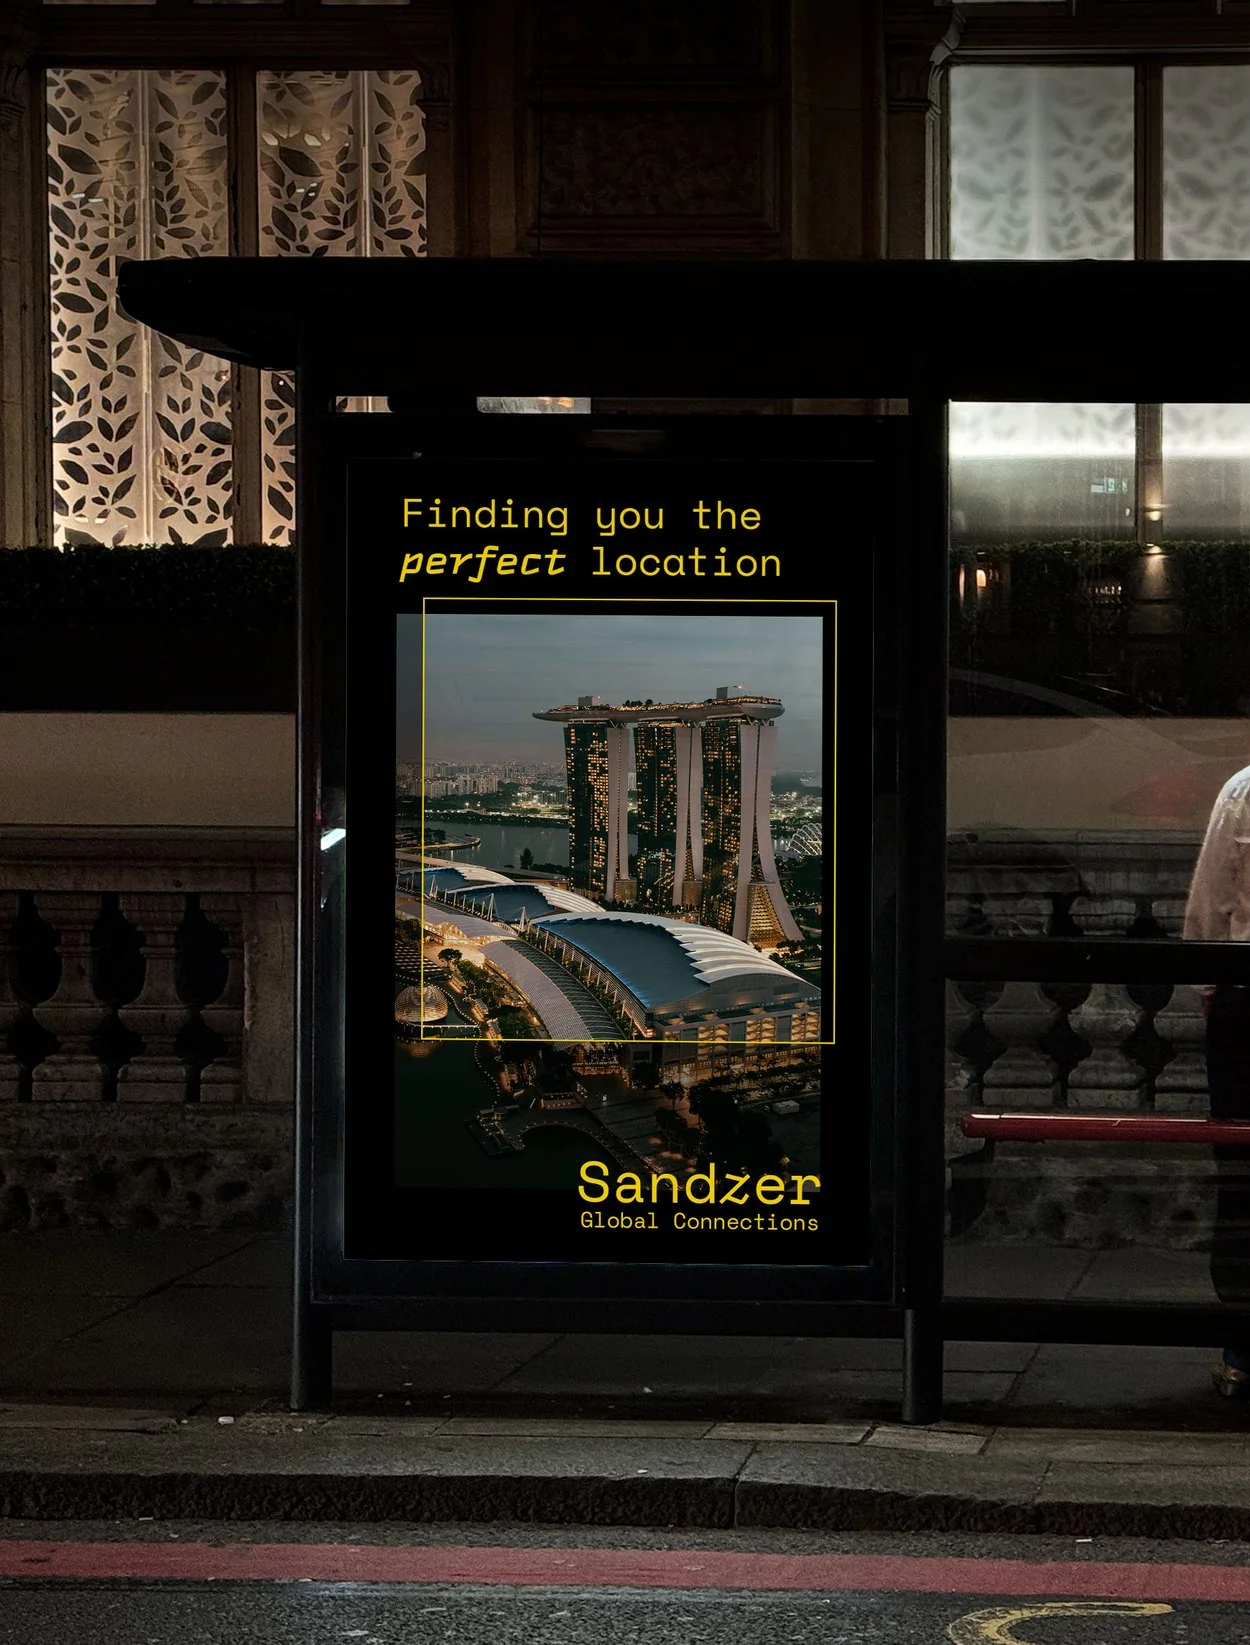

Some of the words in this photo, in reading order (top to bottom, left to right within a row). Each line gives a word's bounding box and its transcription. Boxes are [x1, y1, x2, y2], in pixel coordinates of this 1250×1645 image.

[403, 498, 568, 536] Finding
[596, 507, 663, 537] you
[692, 500, 761, 530] the
[399, 545, 567, 583] perfect
[592, 546, 781, 577] location
[578, 1160, 821, 1205] Sandzer
[580, 1211, 659, 1229] Global
[673, 1212, 819, 1231] Connections
